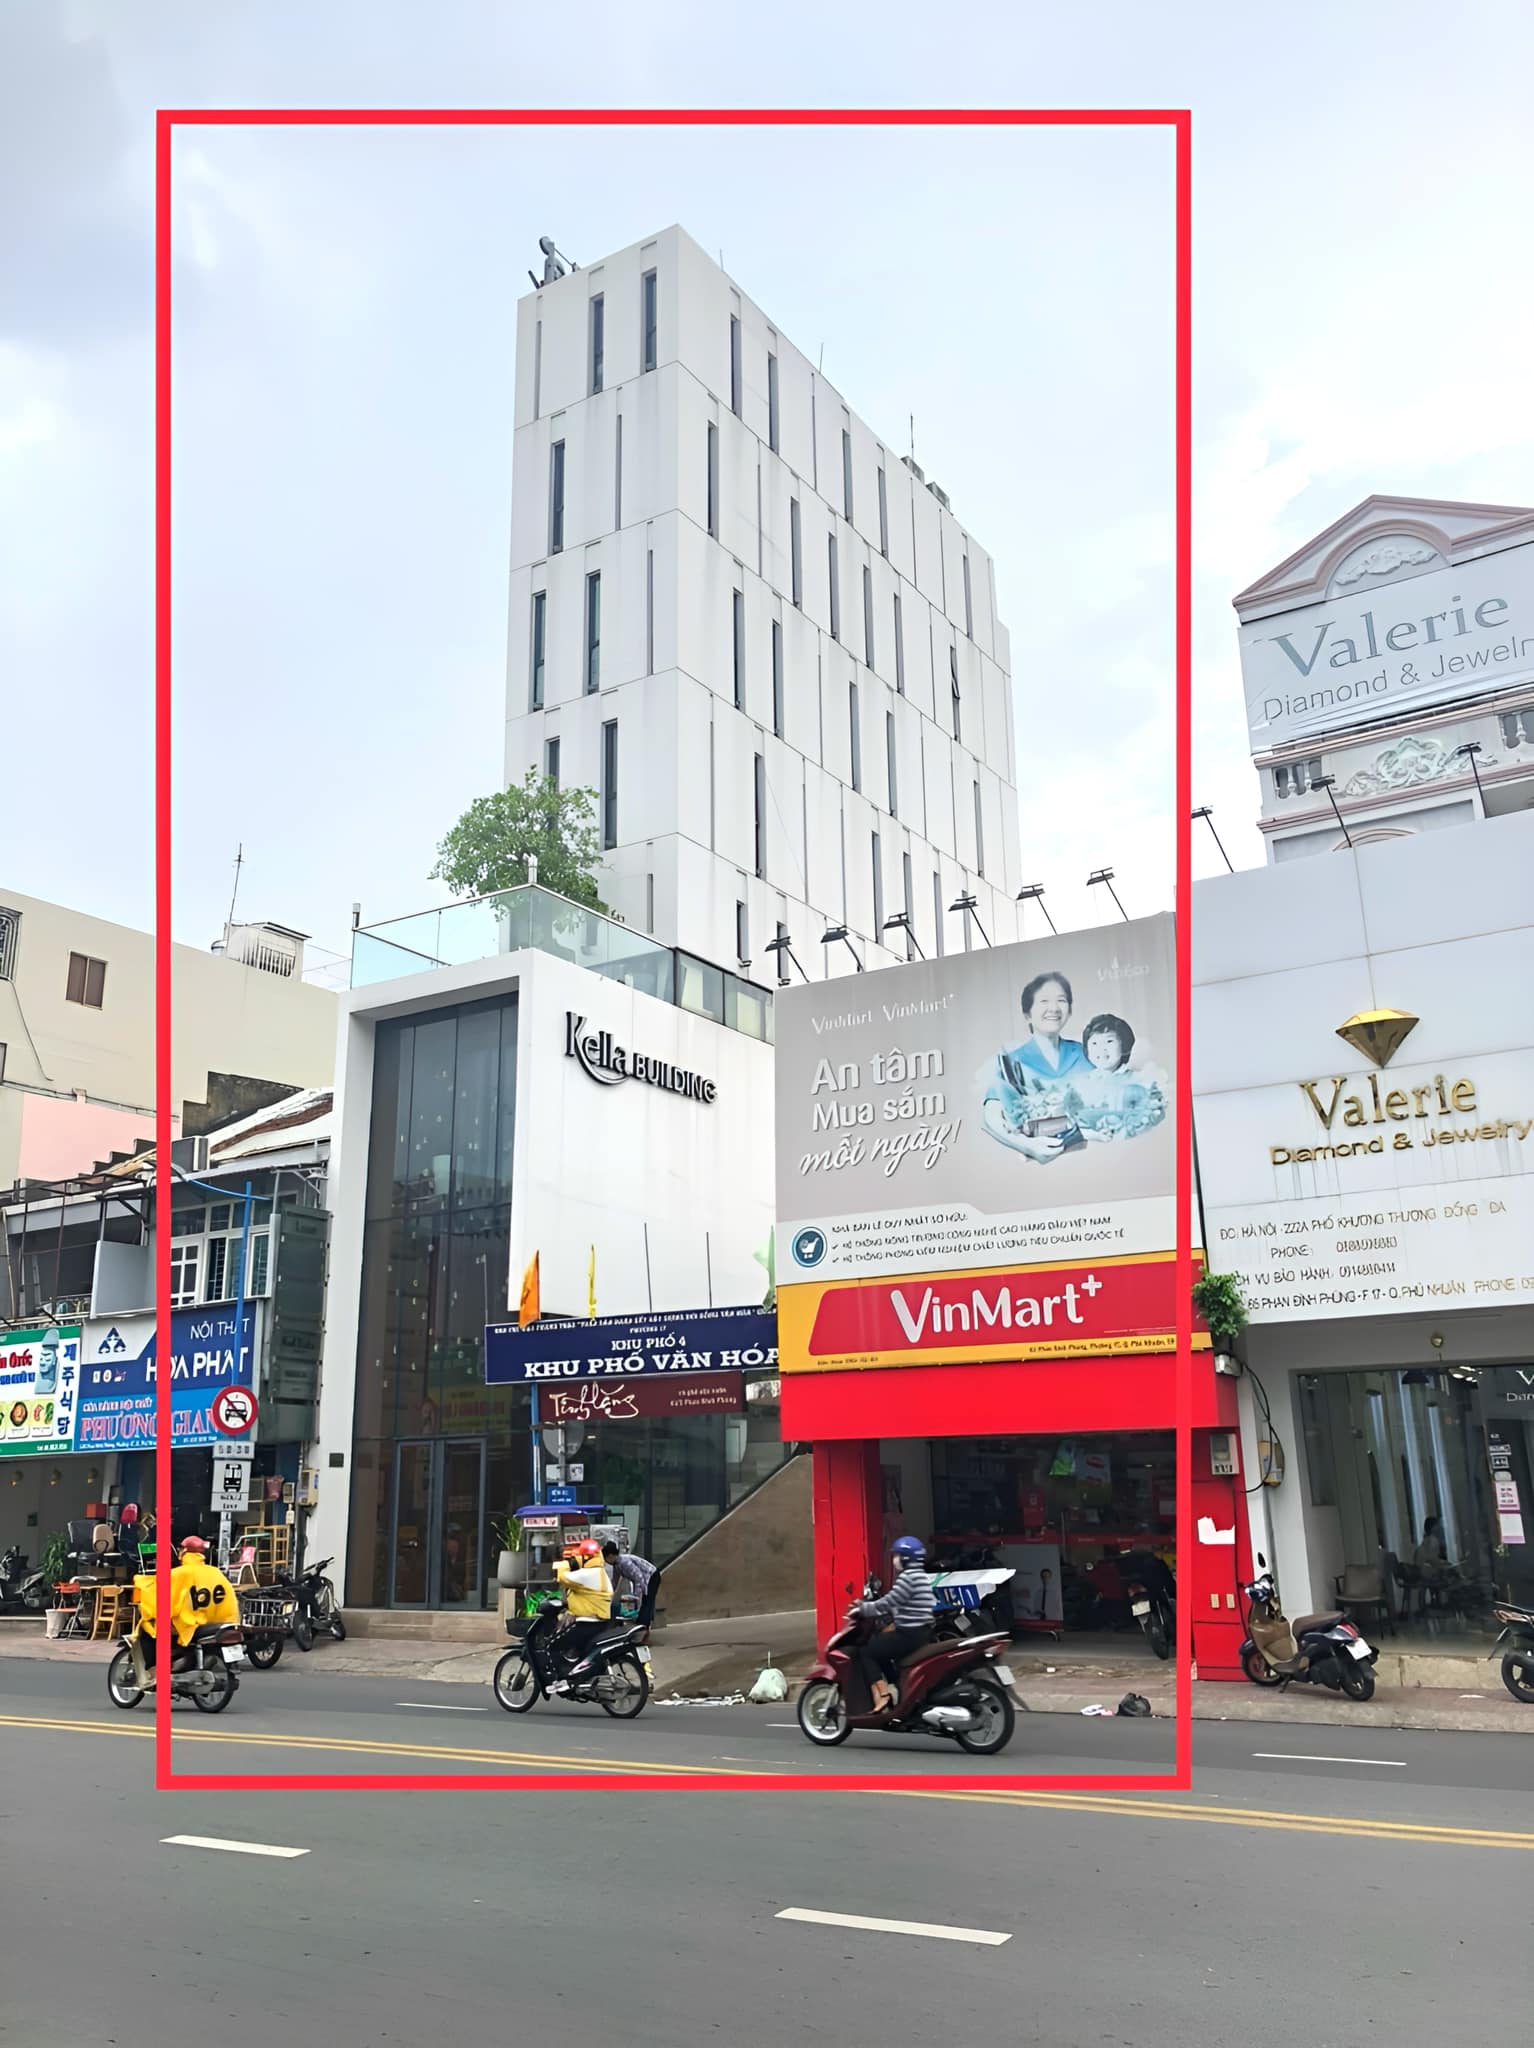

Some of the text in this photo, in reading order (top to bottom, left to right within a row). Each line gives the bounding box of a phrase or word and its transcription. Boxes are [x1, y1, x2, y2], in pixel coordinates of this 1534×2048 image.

[1268, 595, 1510, 677] Valerie
[1264, 669, 1387, 720] Diamond
[1400, 663, 1421, 685] &
[565, 1011, 718, 1104] Kella BUILDING
[810, 1047, 944, 1095] An tâm
[812, 1086, 946, 1132] Mua sắm
[1299, 1074, 1477, 1130] Valerie
[800, 1132, 866, 1176] mỗi
[1270, 1118, 1534, 1165] Diamond & Jewelry
[191, 1318, 250, 1342] NỘI THT
[611, 1338, 642, 1352] KHU
[646, 1332, 676, 1349] PHỐ
[145, 1354, 189, 1382] HA
[524, 1342, 779, 1378] KHU PHỐ VĂN HÓA
[190, 1584, 226, 1611] be
